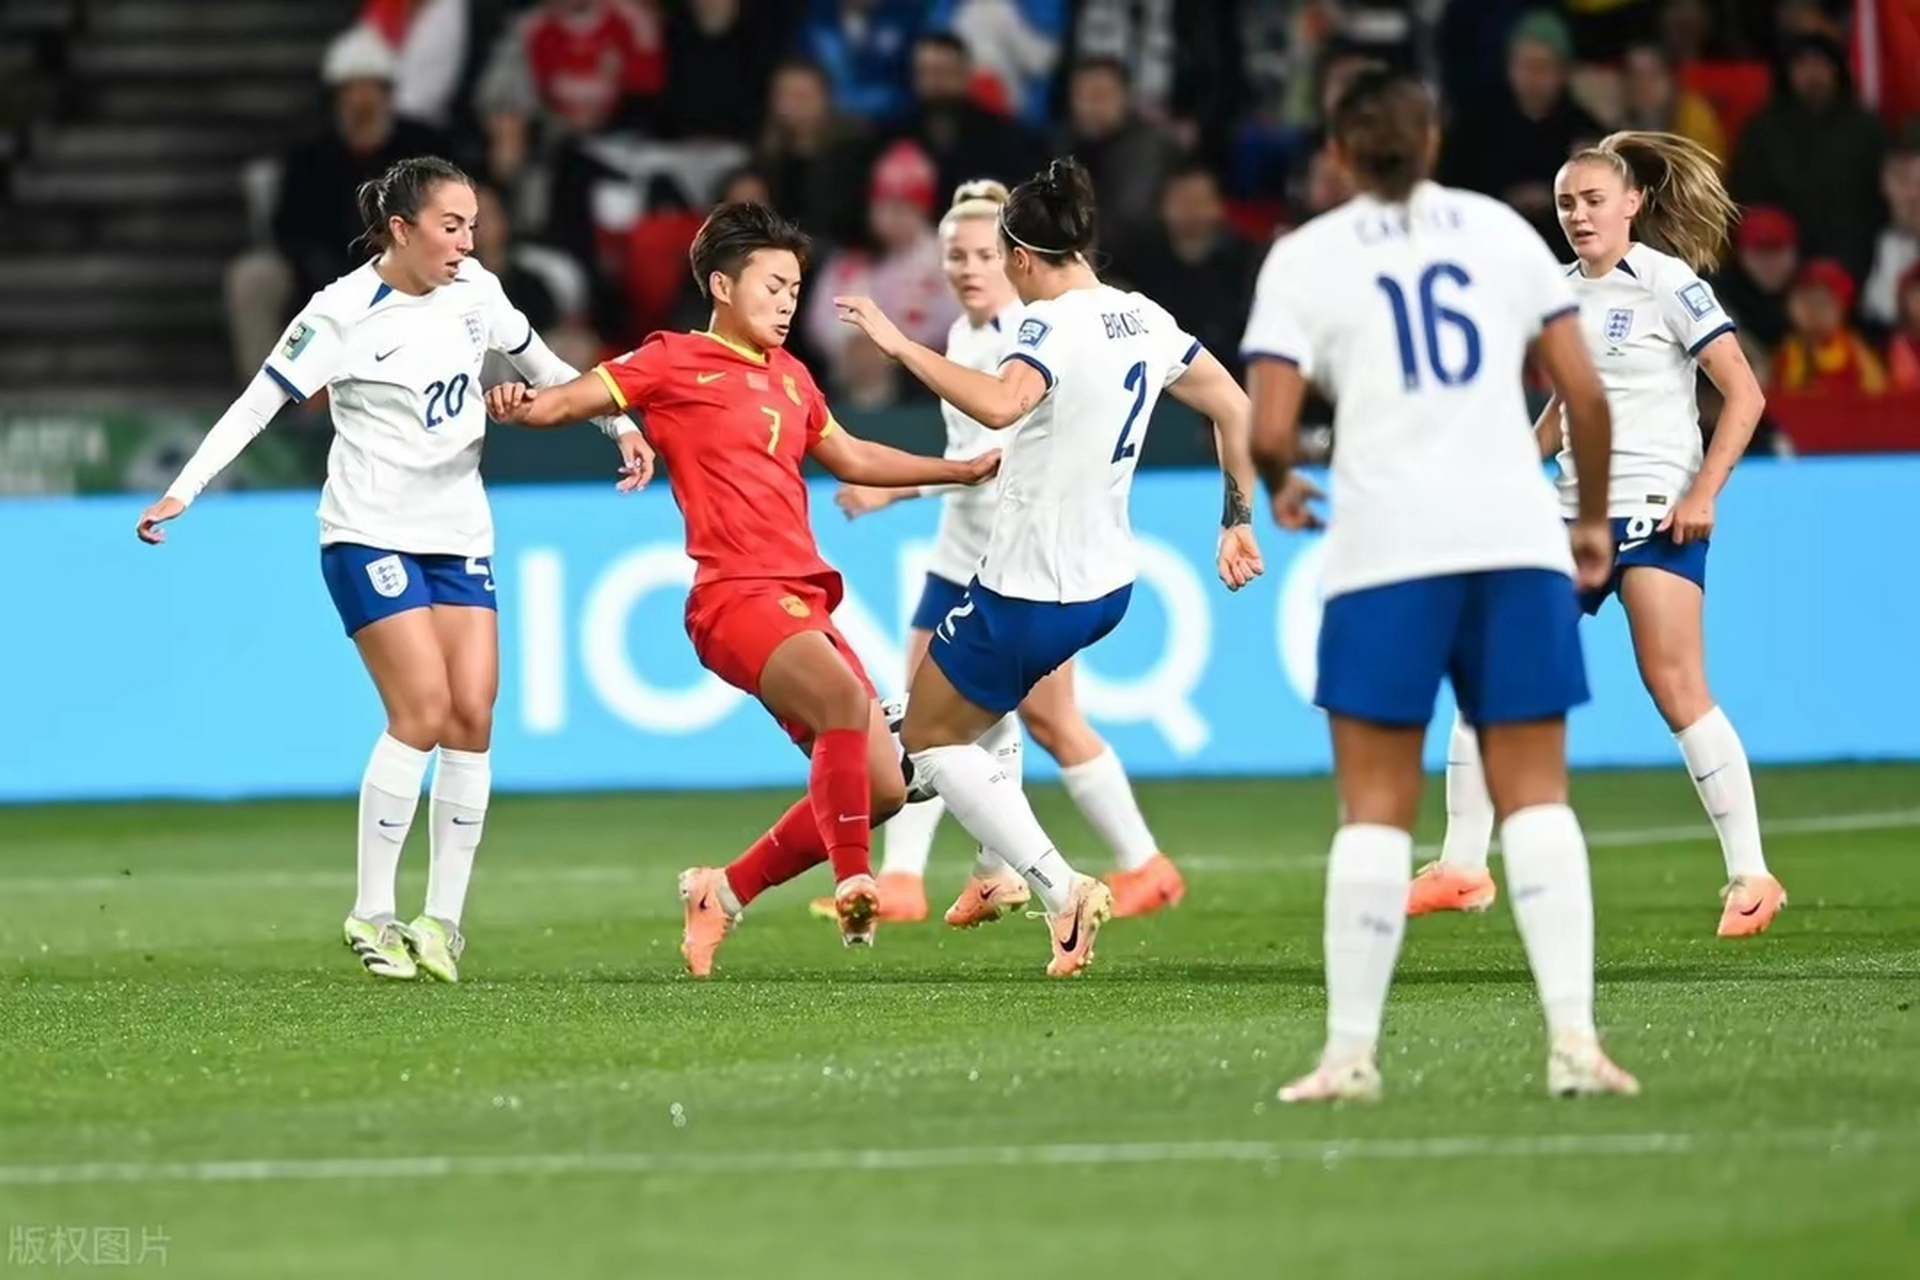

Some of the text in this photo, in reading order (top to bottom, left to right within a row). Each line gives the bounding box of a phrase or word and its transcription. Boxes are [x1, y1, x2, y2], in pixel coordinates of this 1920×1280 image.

[1376, 260, 1481, 394] 16
[423, 373, 469, 428] 20
[760, 405, 781, 456] 7
[1110, 360, 1147, 464] 2
